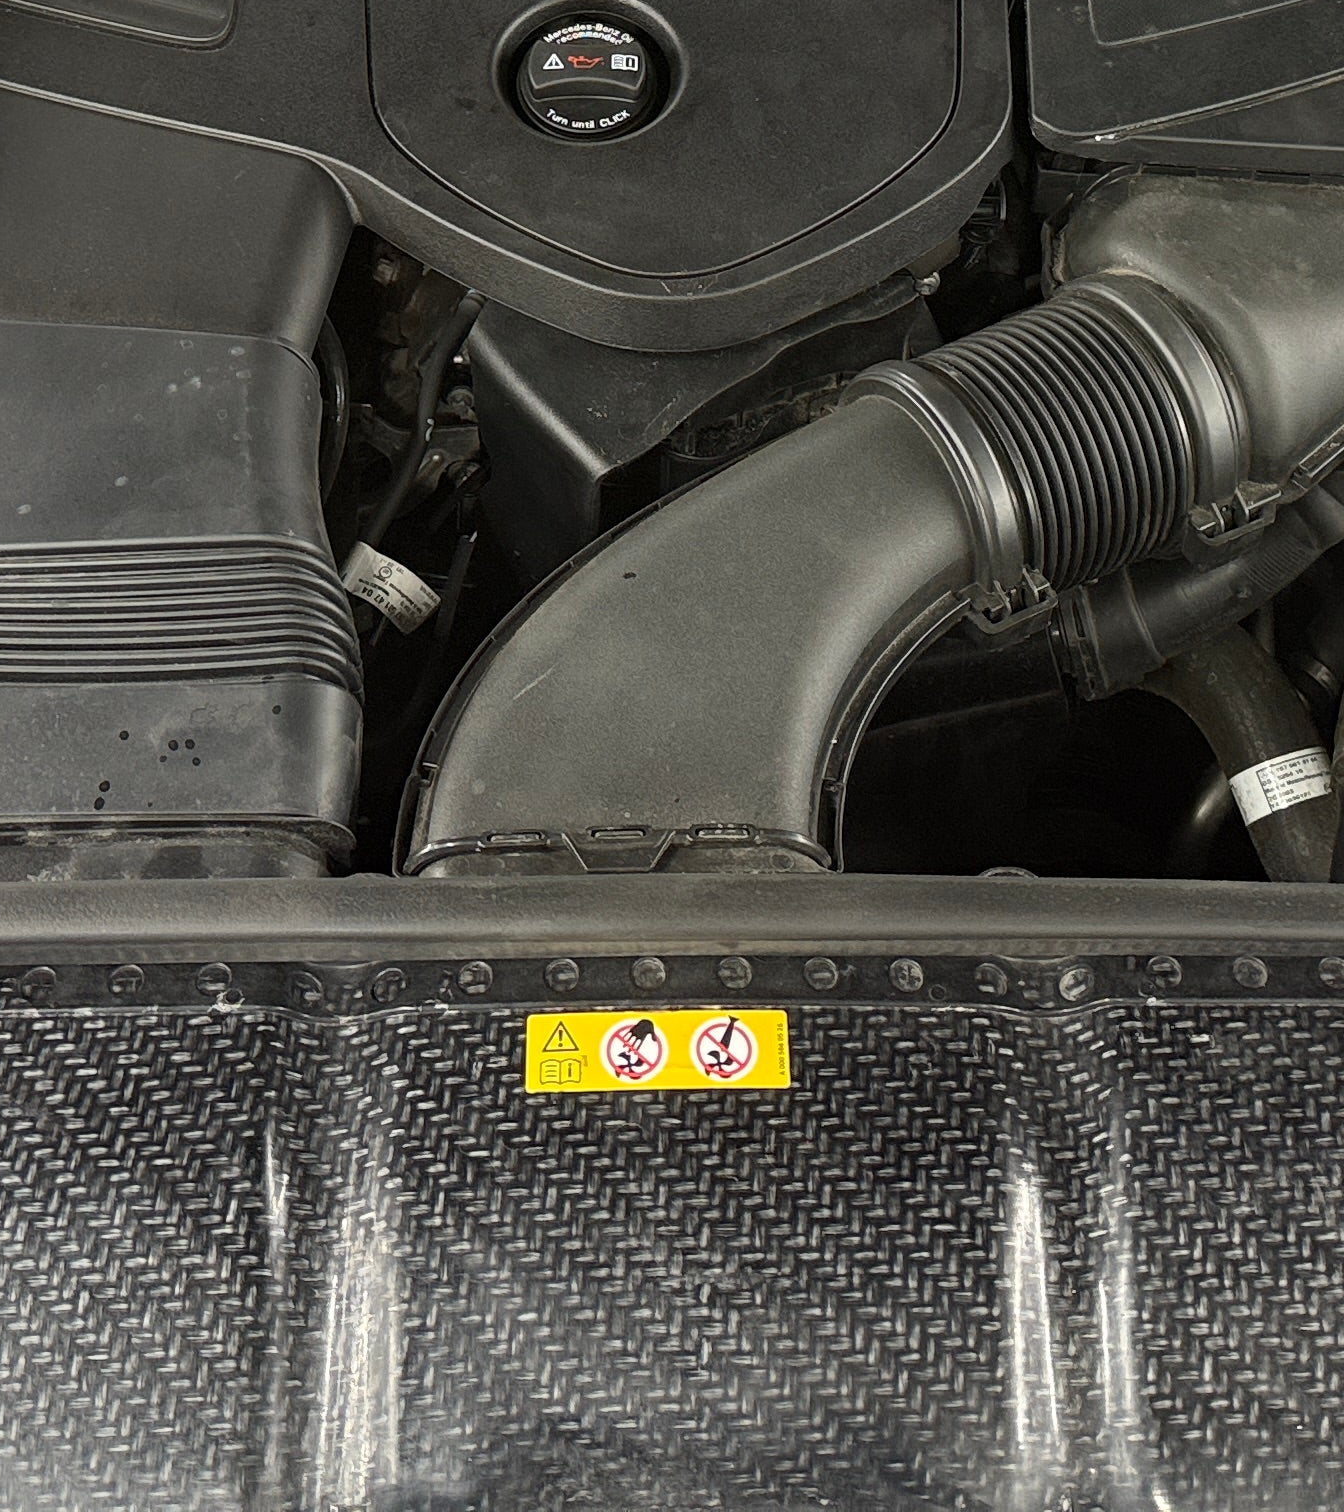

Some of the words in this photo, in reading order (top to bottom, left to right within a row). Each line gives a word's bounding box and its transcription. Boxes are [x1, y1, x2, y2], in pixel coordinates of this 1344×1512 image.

[543, 23, 620, 43] Mercedes-Benz
[557, 31, 623, 45] recommended
[546, 109, 568, 125] Turn
[572, 118, 595, 129] until
[599, 109, 631, 127] CLICK
